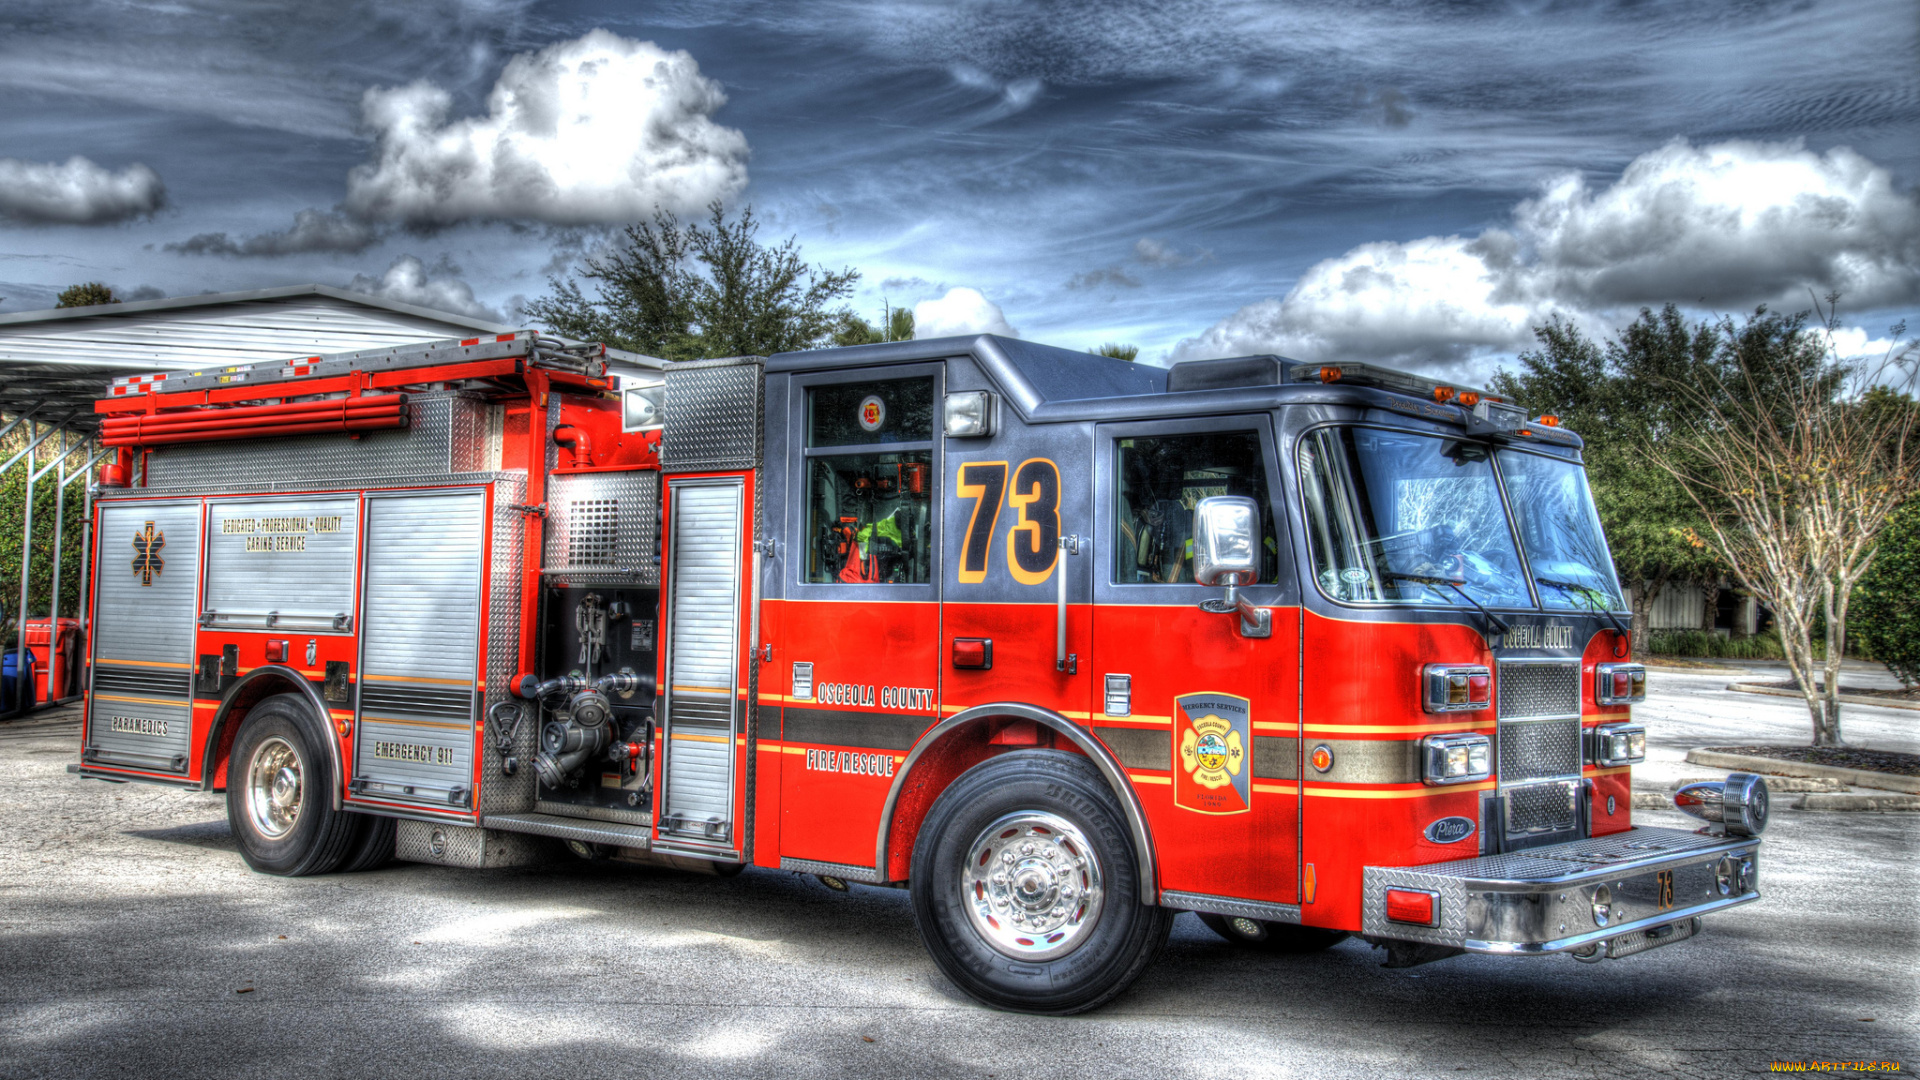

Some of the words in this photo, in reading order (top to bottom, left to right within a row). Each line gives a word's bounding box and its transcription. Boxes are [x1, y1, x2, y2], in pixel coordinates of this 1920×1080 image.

[222, 518, 256, 534] DEDICATED
[260, 517, 308, 533] PROFESSIONAL
[314, 516, 342, 535] QUALITY
[957, 457, 1061, 585] 73
[246, 536, 273, 552] CARING
[275, 536, 306, 552] SERVICE
[1544, 625, 1574, 649] COUNTY
[818, 682, 875, 707] OSCEOLA
[881, 686, 934, 711] COUNTY
[1216, 702, 1246, 714] SERVICES
[111, 716, 168, 736] PARAMEDICS
[1212, 721, 1226, 731] COUNTY
[374, 741, 433, 764] EMERGENCY
[436, 746, 453, 766] 911
[806, 748, 893, 777] FIRE/RESCUE
[1435, 821, 1465, 840] Pierce
[1044, 783, 1133, 904] BRIDGESTONE
[1657, 869, 1674, 910] 73
